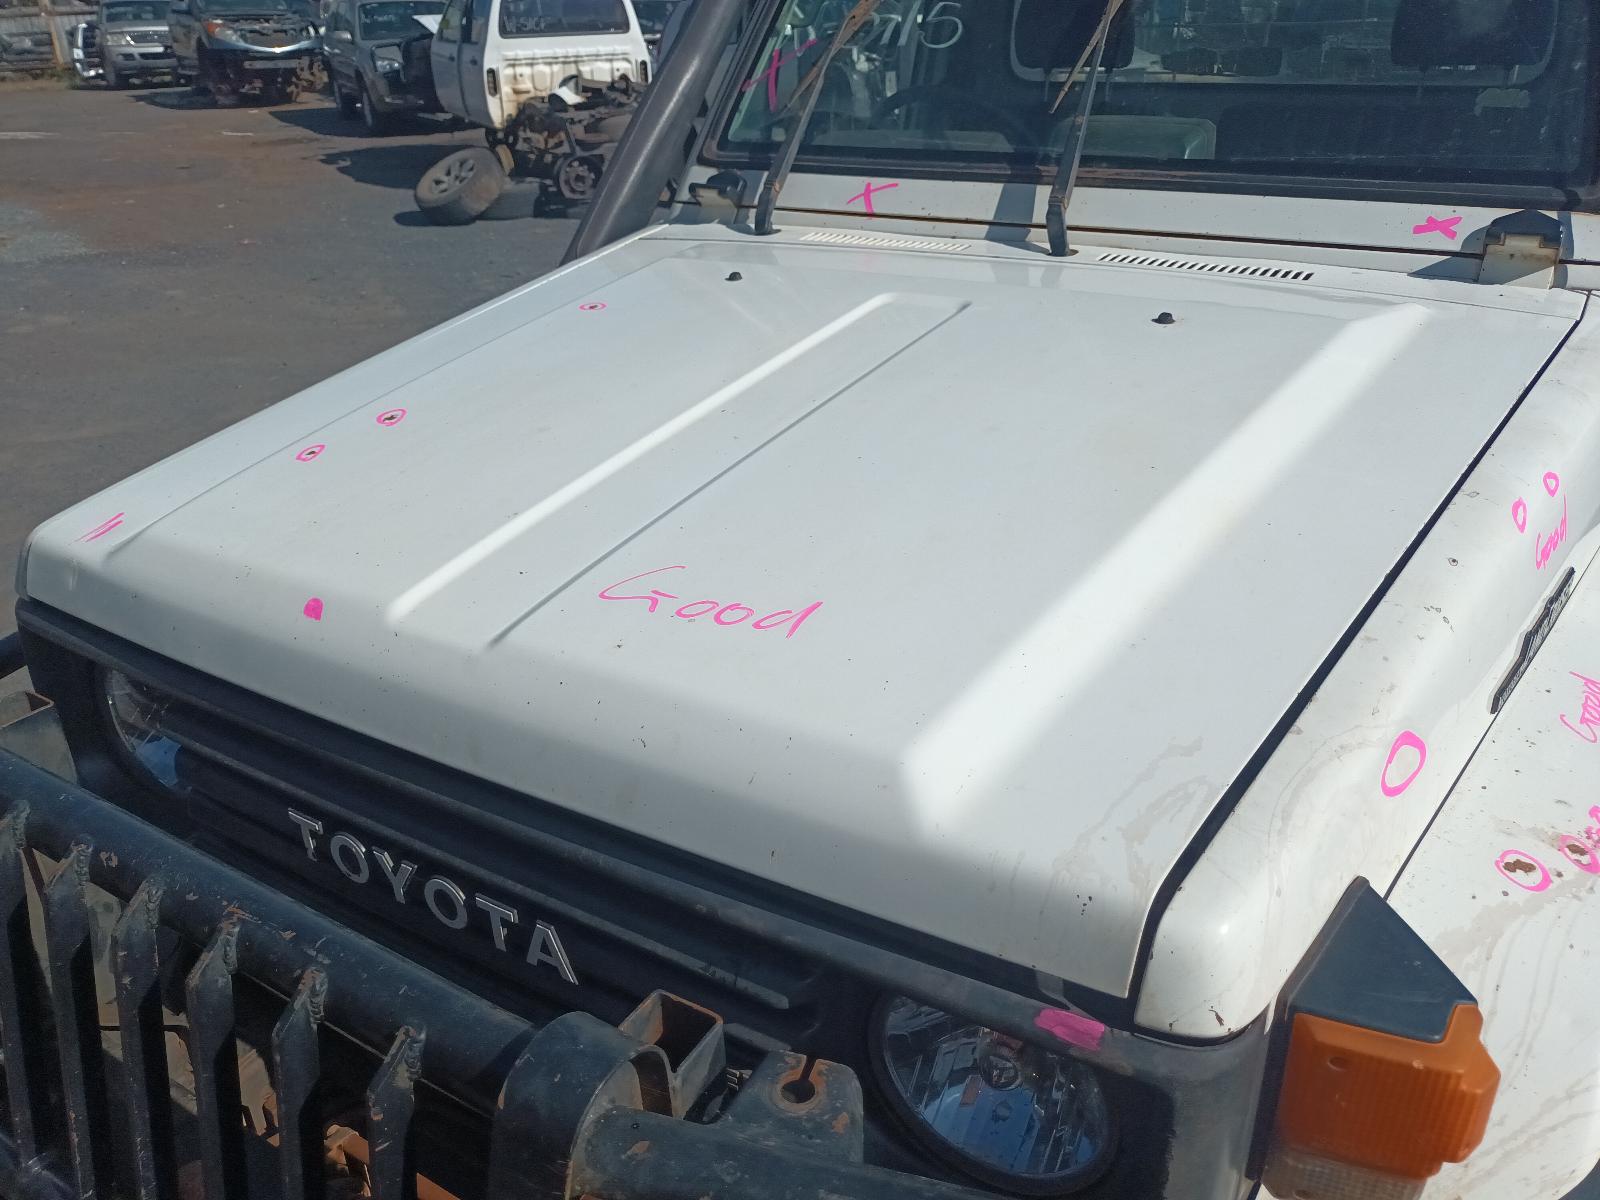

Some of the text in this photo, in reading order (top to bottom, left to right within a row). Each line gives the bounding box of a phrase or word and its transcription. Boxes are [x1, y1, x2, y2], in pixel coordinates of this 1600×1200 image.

[1535, 492, 1568, 570] Good
[598, 565, 824, 639] Good
[287, 807, 580, 986] TOYOTA
